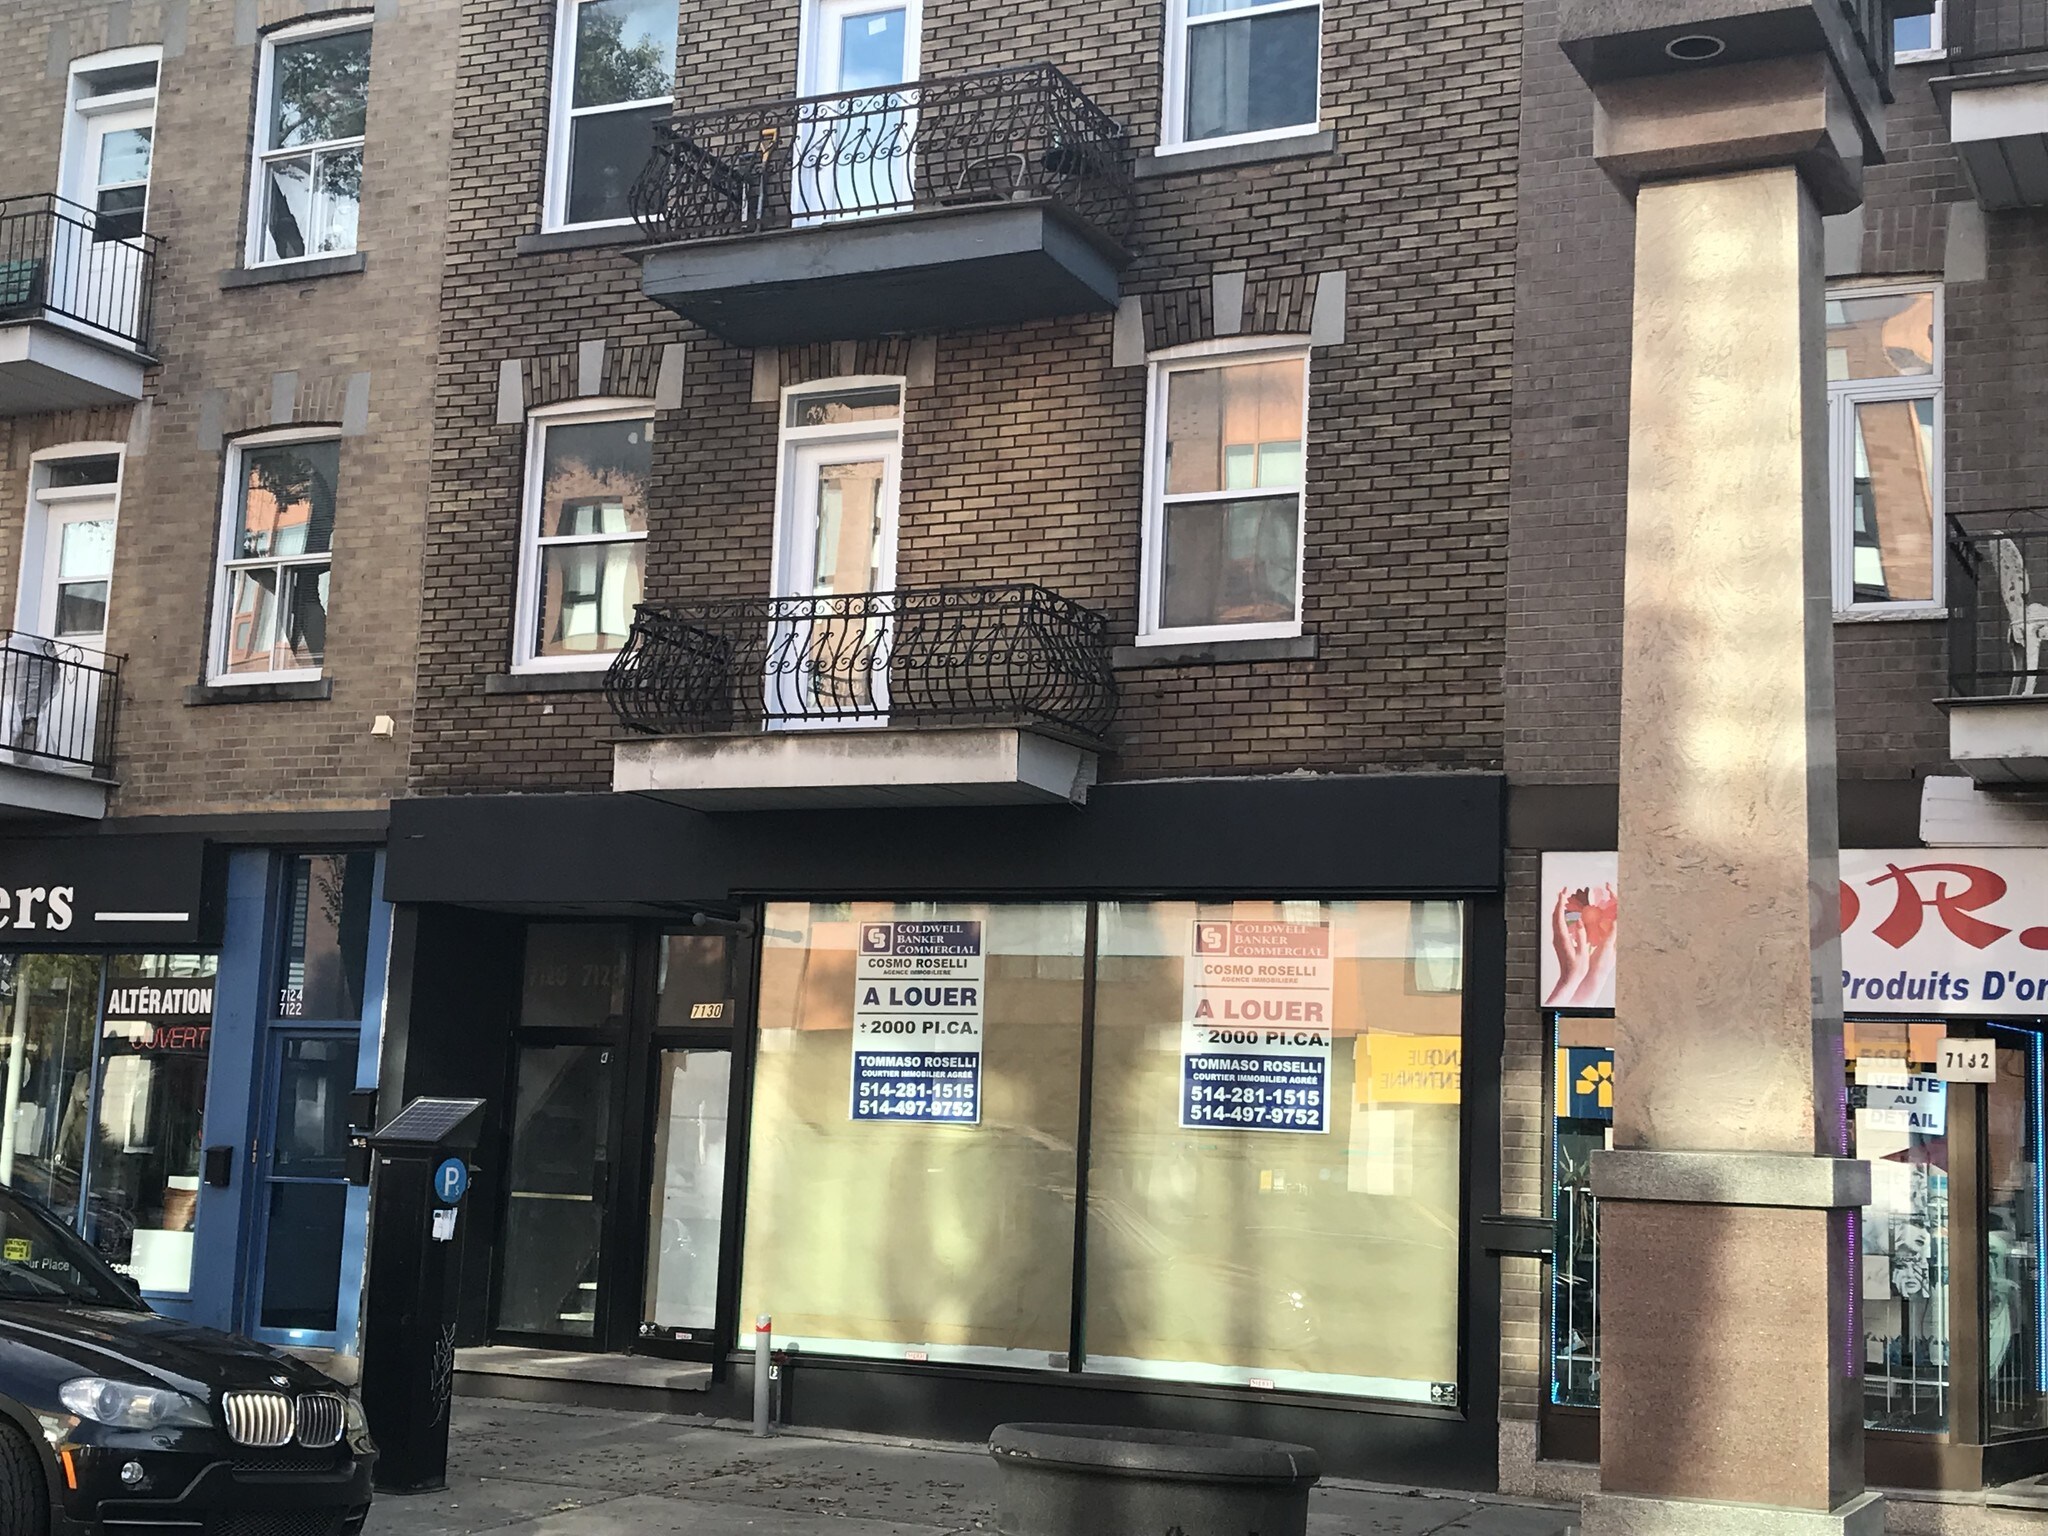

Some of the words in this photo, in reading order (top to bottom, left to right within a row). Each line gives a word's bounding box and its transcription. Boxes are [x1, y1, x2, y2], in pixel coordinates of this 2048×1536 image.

[897, 924, 964, 934] COLDWELL
[1234, 923, 1309, 934] COLDWELL
[897, 934, 944, 944] BANKER
[1234, 935, 1288, 945] BANKER
[896, 945, 977, 955] COMMERCIAL
[1233, 945, 1325, 957] COMMERCIAL
[868, 958, 912, 968] COSMO
[916, 958, 968, 969] ROSELLI
[1204, 964, 1254, 976] COSMO
[1258, 965, 1316, 977] ROSELLI
[108, 986, 212, 1014] ALTÉRATION
[280, 989, 303, 1001] 7124
[863, 986, 880, 1006] A
[889, 986, 977, 1006] LOUER
[280, 1002, 302, 1015] 7122
[693, 1004, 722, 1018] 7130
[1194, 998, 1214, 1019] A
[1224, 999, 1323, 1022] LOUER
[870, 1020, 916, 1034] 2000
[921, 1021, 979, 1035] PI.CA.
[1208, 1029, 1258, 1045] 2000
[1265, 1031, 1330, 1047] PI.CA.
[859, 1056, 921, 1067] TOMMASO
[924, 1056, 977, 1068] ROSELLI
[1189, 1057, 1259, 1071] TOMMASO
[1263, 1060, 1322, 1074] ROSELLI
[1945, 1052, 1989, 1069] 7132
[861, 1069, 900, 1078] COURTIER
[901, 1070, 946, 1078] IMMOBILIER
[1193, 1072, 1236, 1081] COURTIER
[1237, 1073, 1288, 1083] IMMOBILIER
[1873, 1073, 1940, 1093] VENTE
[859, 1082, 974, 1098] 514-281-1515
[1190, 1086, 1319, 1106] 514-281-1515
[1894, 1094, 1917, 1105] AU
[858, 1100, 973, 1117] 514-497-9752
[1190, 1104, 1319, 1125] 514-497-9752
[42, 1258, 70, 1271] Place
